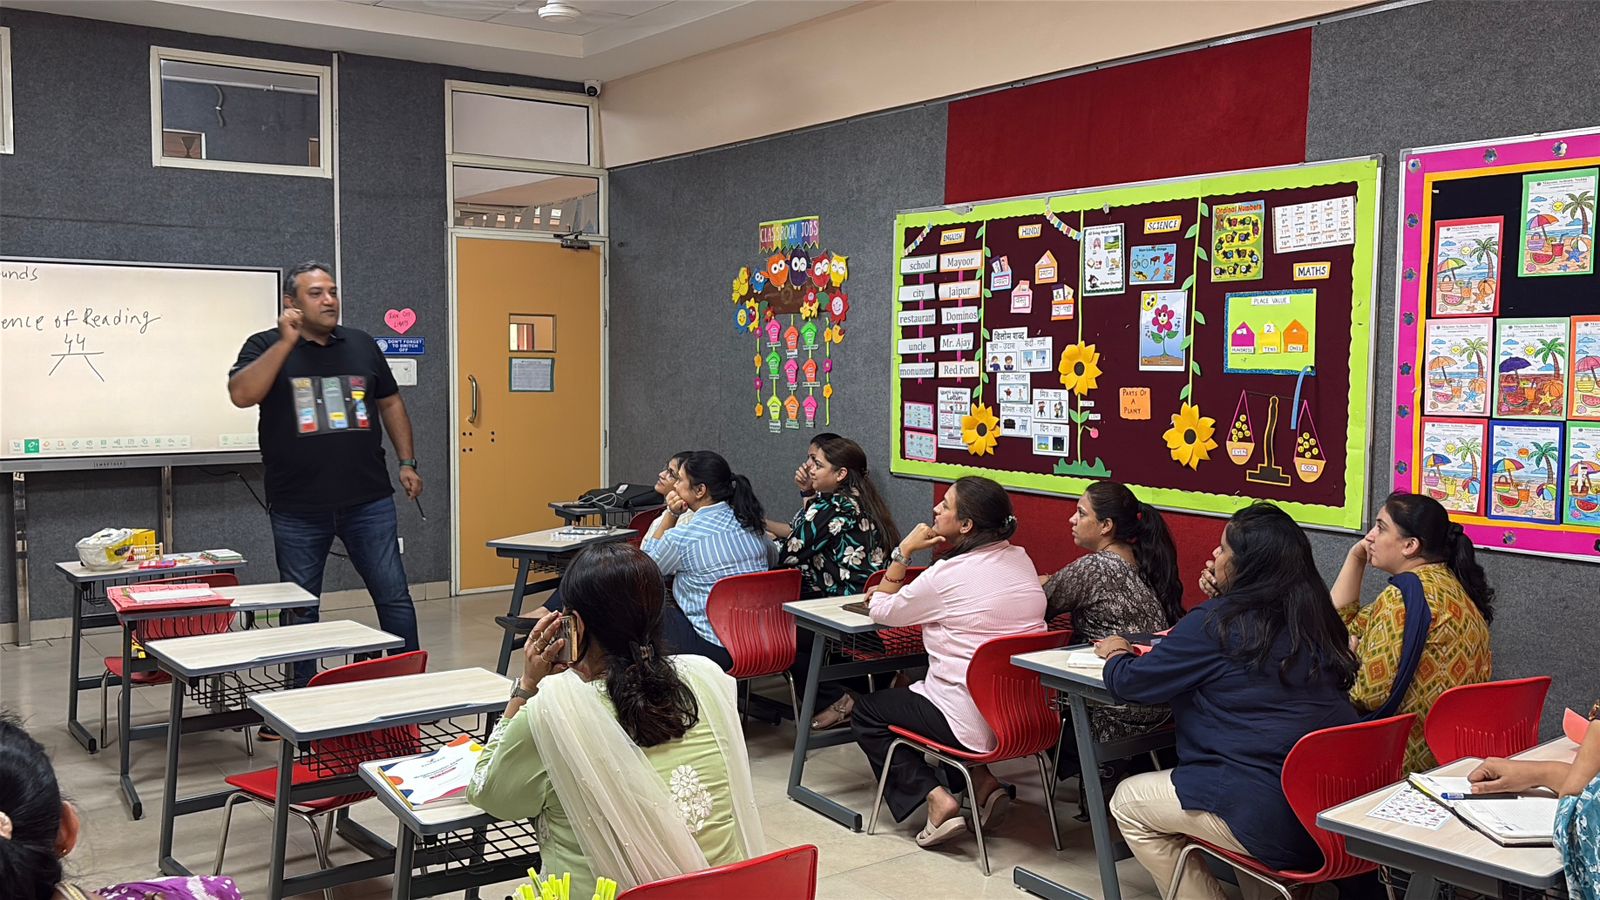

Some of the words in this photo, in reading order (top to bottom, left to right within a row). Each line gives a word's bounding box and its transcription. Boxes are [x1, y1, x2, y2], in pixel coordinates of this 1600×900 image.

[1021, 226, 1040, 236] HINDI
[1147, 220, 1178, 231] SCIENCE
[760, 223, 798, 243] CLASSROOM
[801, 220, 819, 237] JOBS
[943, 232, 963, 241] ENGLISH
[909, 259, 931, 270] school
[947, 257, 975, 268] Mayoor
[1297, 266, 1327, 276] MATHS
[912, 287, 925, 299] city
[948, 286, 971, 298] Jaipur
[1, 314, 44, 331] ence
[54, 309, 78, 329] of
[84, 308, 162, 334] Reading
[900, 312, 935, 324] restaurant
[946, 311, 978, 322] Dominos
[1266, 325, 1272, 333] 2
[64, 333, 86, 354] 44
[908, 342, 927, 351] uncle
[942, 337, 955, 348] Mr.
[956, 336, 971, 348] Ajay
[900, 366, 934, 376] monument
[944, 364, 957, 375] Red
[959, 364, 975, 375] Fort
[1124, 406, 1141, 415] PLANT
